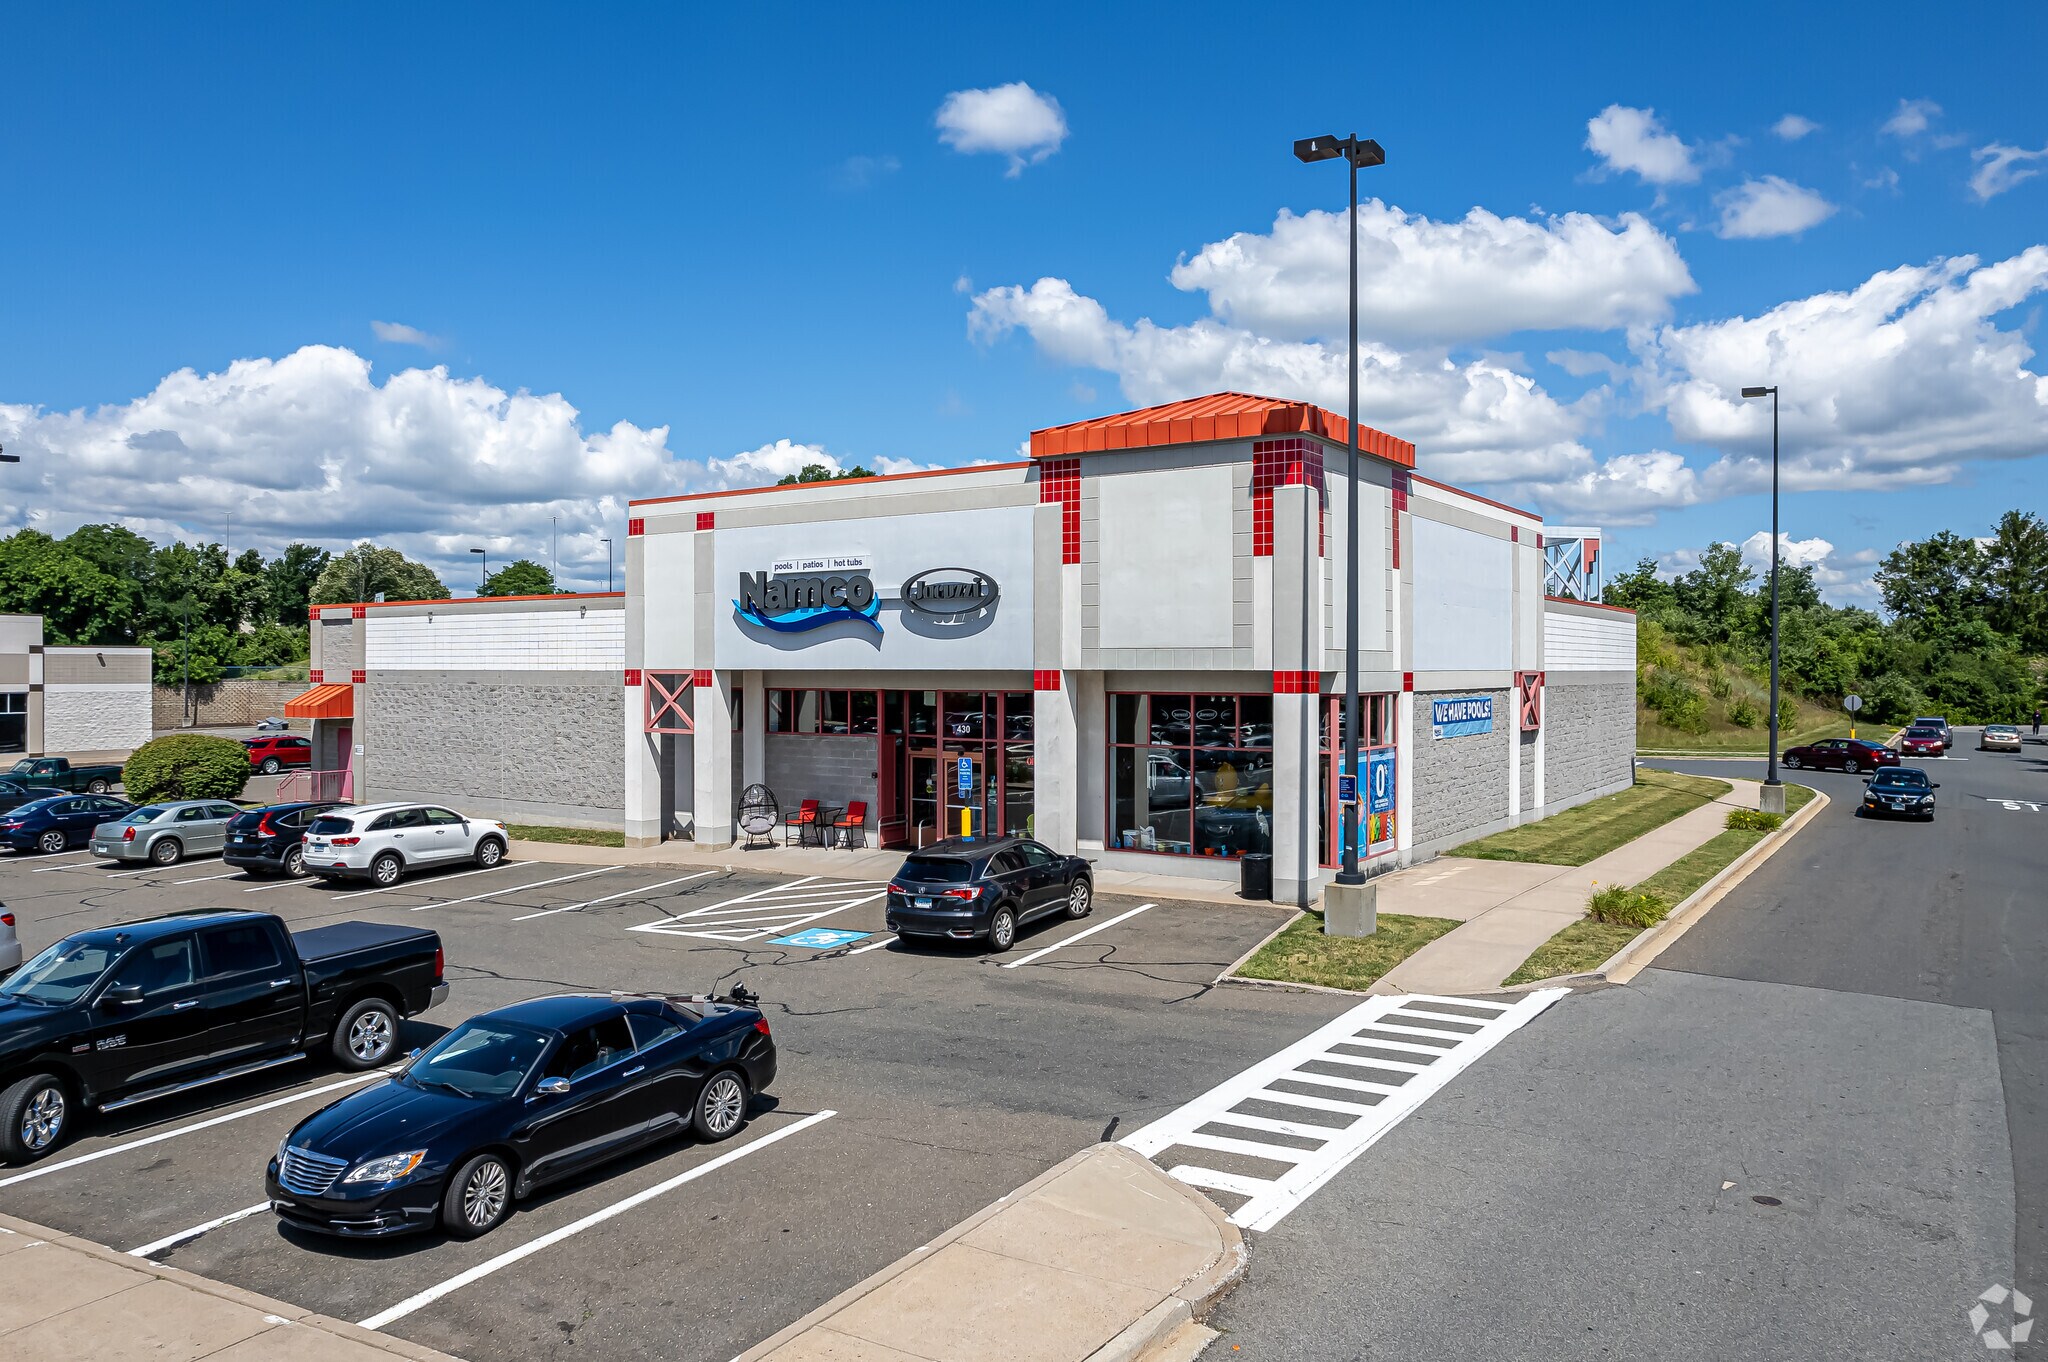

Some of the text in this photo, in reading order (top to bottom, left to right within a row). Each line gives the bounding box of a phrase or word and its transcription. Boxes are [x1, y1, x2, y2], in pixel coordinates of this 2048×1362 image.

[774, 558, 863, 572] pools patios hot tubs
[740, 571, 875, 610] Namco
[1435, 700, 1491, 722] WE HAVE POOLS!
[956, 725, 971, 734] 430
